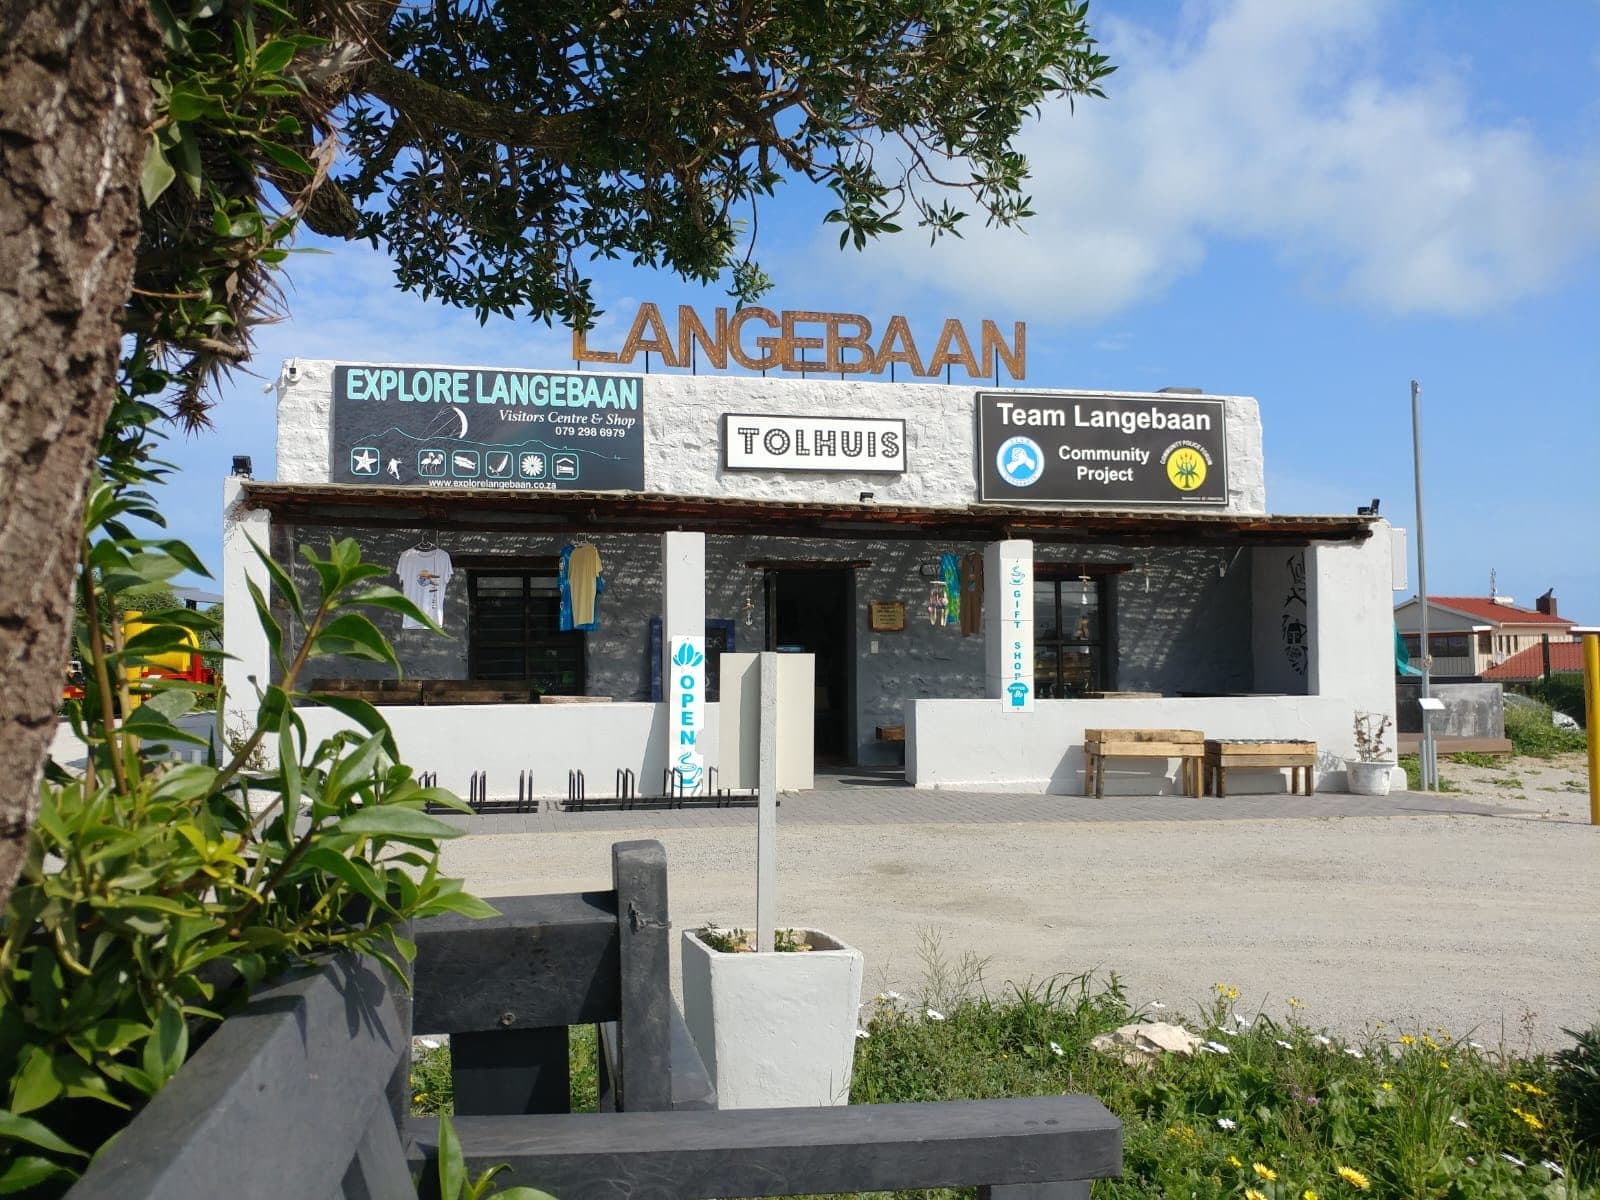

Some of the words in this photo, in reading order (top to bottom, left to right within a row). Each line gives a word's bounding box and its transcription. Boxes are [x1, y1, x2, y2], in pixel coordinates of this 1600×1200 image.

[573, 302, 1026, 380] LANGEBAAN
[346, 368, 469, 403] EXPLORE
[476, 372, 638, 410] LANGEBAAN
[499, 409, 545, 423] Visitors
[548, 411, 588, 424] Centre
[591, 413, 603, 424] &
[606, 413, 636, 429] Shop
[555, 426, 575, 436] 079
[577, 427, 597, 437] 298
[599, 428, 625, 438] 6979
[997, 402, 1065, 427] Team
[1074, 405, 1211, 434] Langebaan
[737, 426, 900, 458] TOLHUIS
[1058, 445, 1150, 465] Community
[428, 479, 557, 490] www.explorelangebaan.co.za
[1076, 465, 1134, 484] Project
[1013, 590, 1021, 629] GIFT
[1013, 641, 1021, 681] SHOP
[680, 675, 695, 745] OPEN
